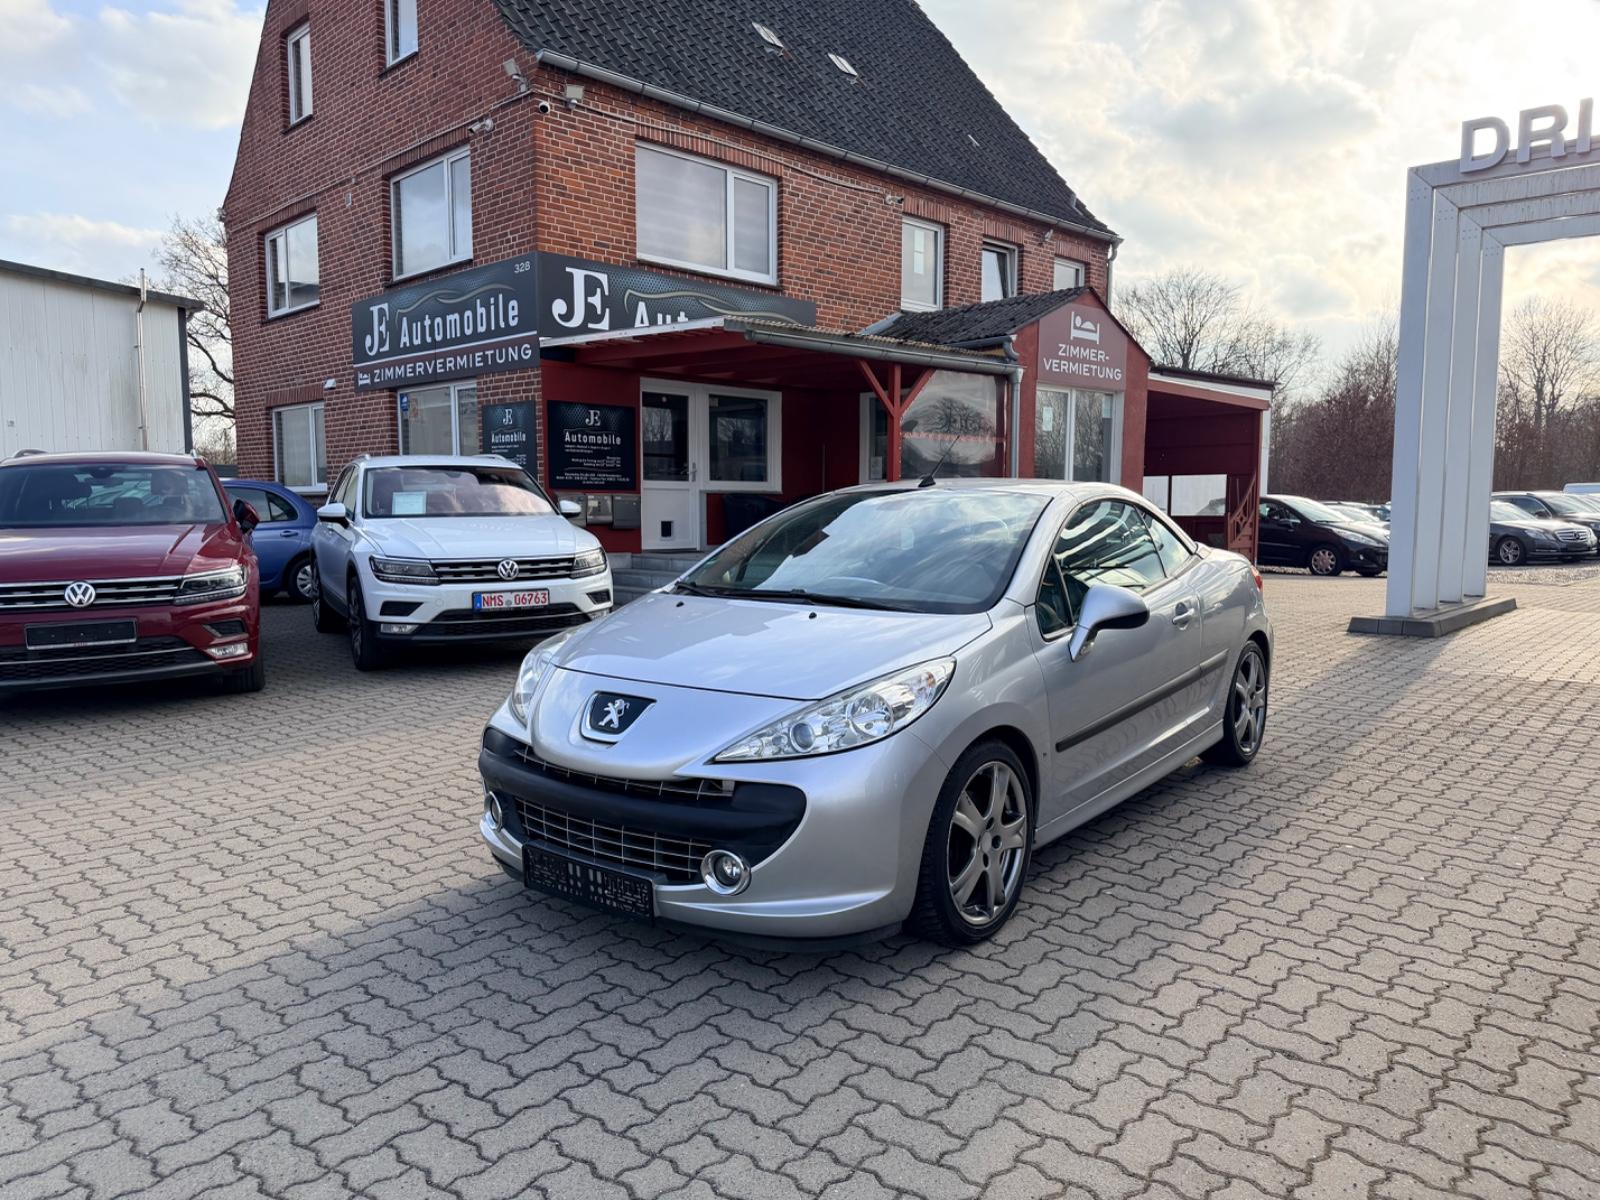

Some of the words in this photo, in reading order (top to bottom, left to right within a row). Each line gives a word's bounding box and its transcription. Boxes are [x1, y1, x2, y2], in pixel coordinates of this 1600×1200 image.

[514, 261, 531, 273] 328
[400, 293, 519, 348] Automobile
[1058, 344, 1109, 362] ZIMMER-
[374, 344, 532, 382] ZIMMERVERMIETUNG
[1043, 358, 1122, 380] VERMIETUNG
[564, 431, 621, 445] Automobile
[482, 594, 504, 607] NMS
[514, 592, 547, 605] 06763
